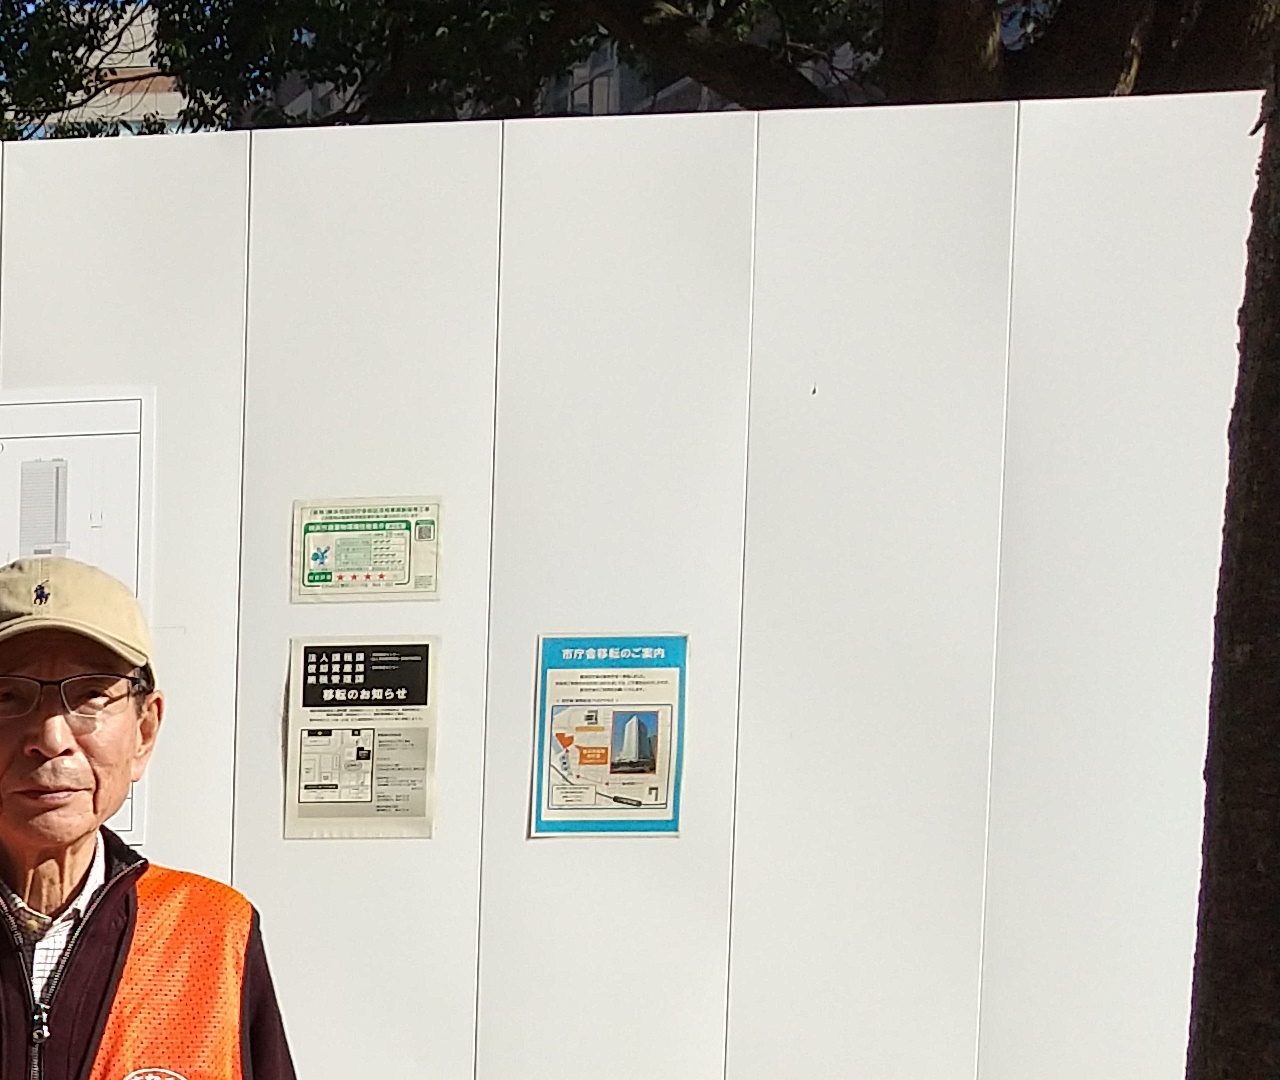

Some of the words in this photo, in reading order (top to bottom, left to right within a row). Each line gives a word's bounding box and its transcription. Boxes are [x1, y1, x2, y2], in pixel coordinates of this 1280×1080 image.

[561, 647, 665, 660] 市庁舎移転のご案内
[322, 688, 407, 701] 移転のお知らせ
